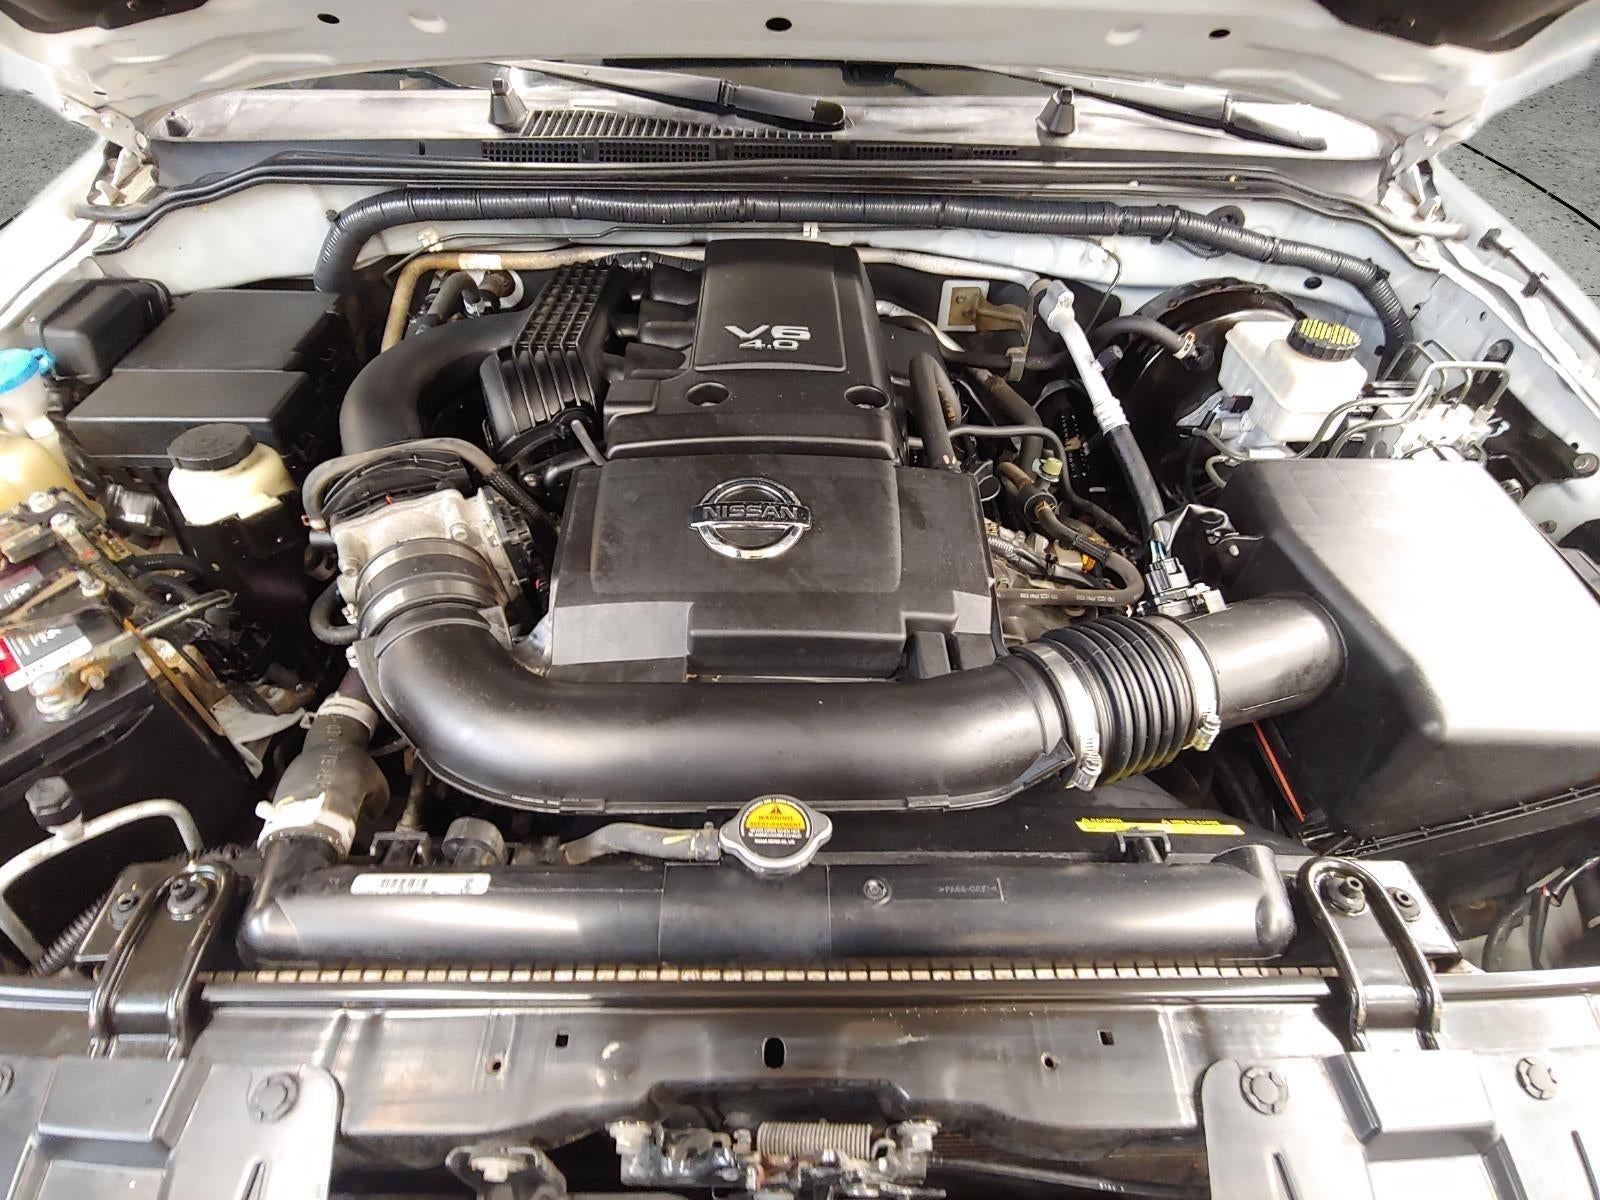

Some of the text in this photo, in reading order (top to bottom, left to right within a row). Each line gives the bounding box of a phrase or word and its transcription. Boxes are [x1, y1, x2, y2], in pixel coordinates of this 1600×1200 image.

[724, 324, 811, 341] V6
[738, 339, 799, 350] 4.0
[703, 505, 798, 520] NISSAN
